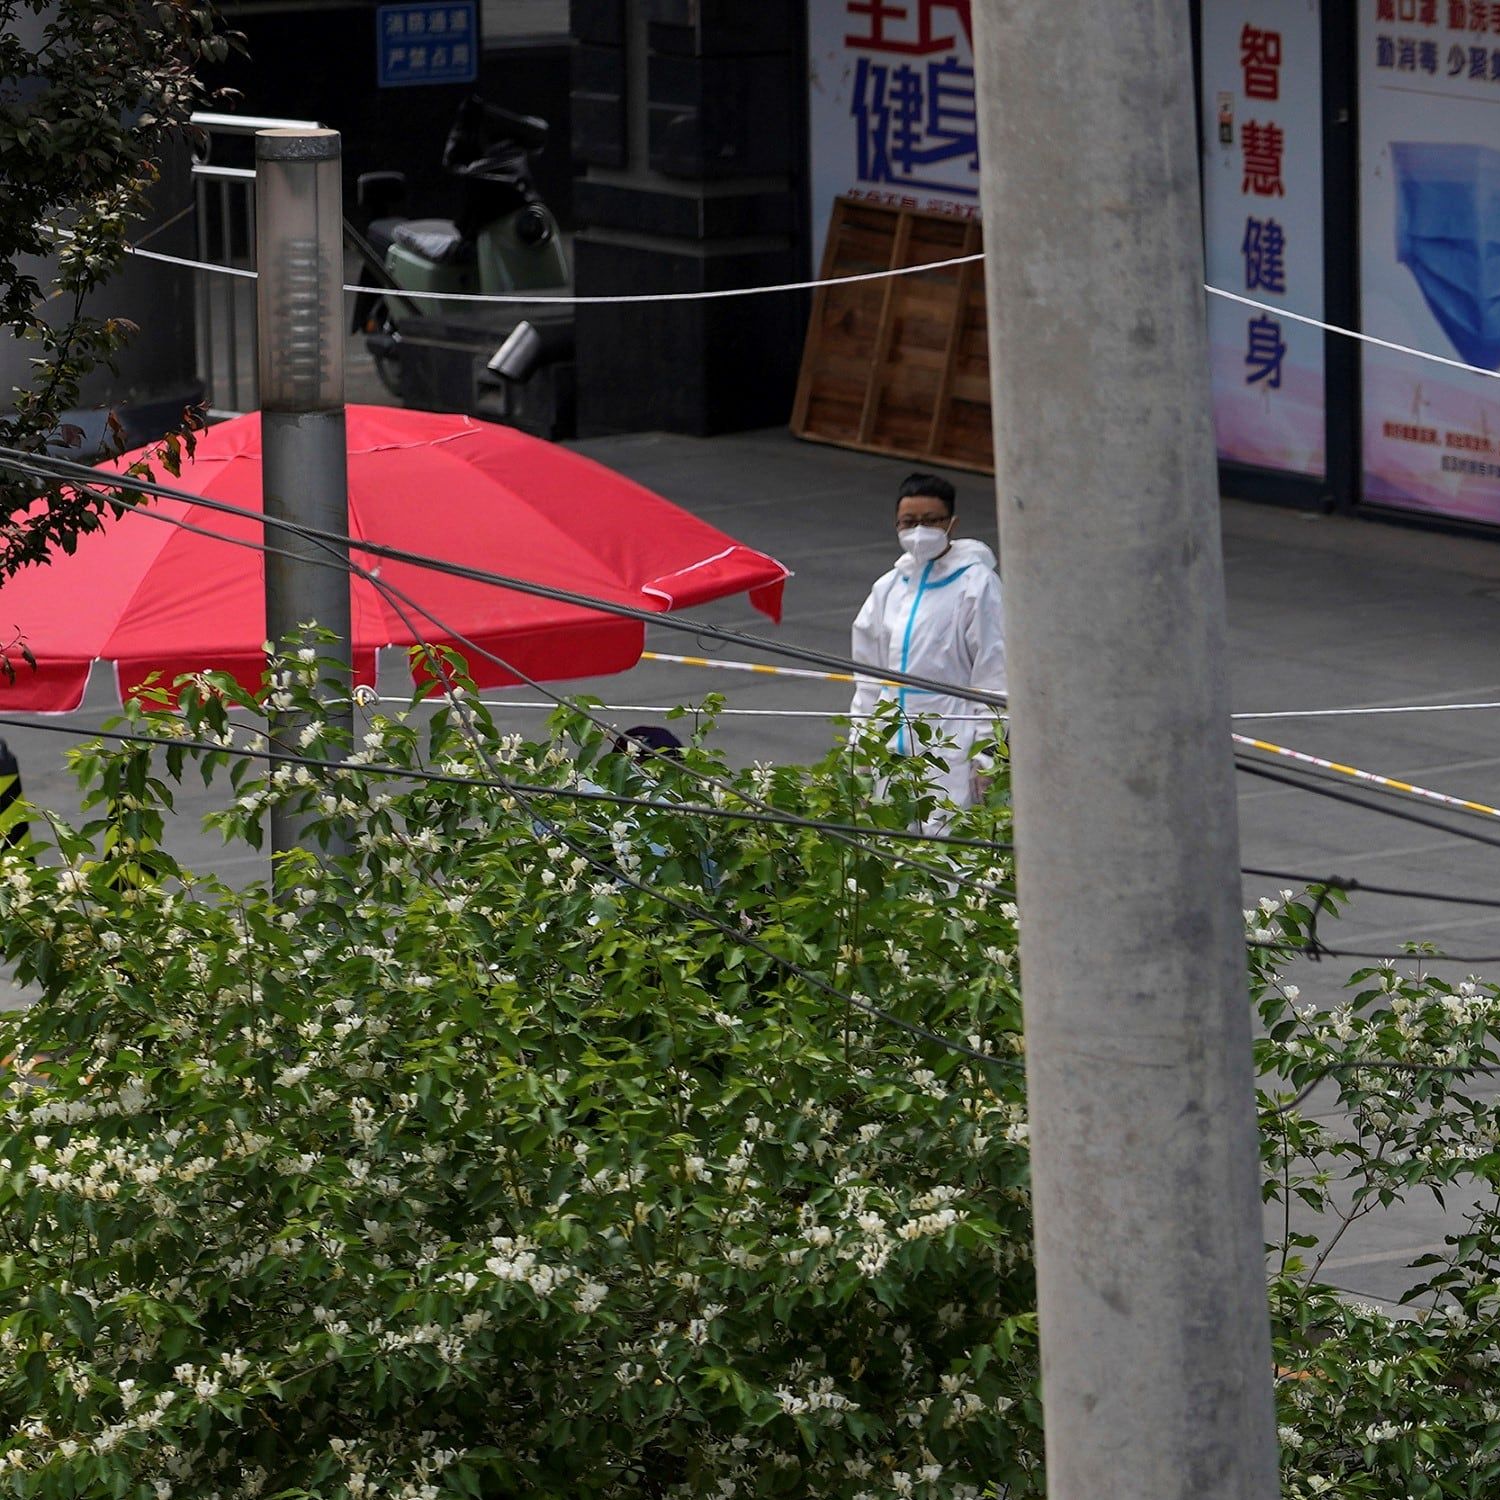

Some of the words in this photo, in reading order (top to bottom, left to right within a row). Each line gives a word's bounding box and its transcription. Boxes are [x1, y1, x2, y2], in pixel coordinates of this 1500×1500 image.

[852, 57, 980, 196] 健身
[1240, 22, 1287, 391] 智慧健身
